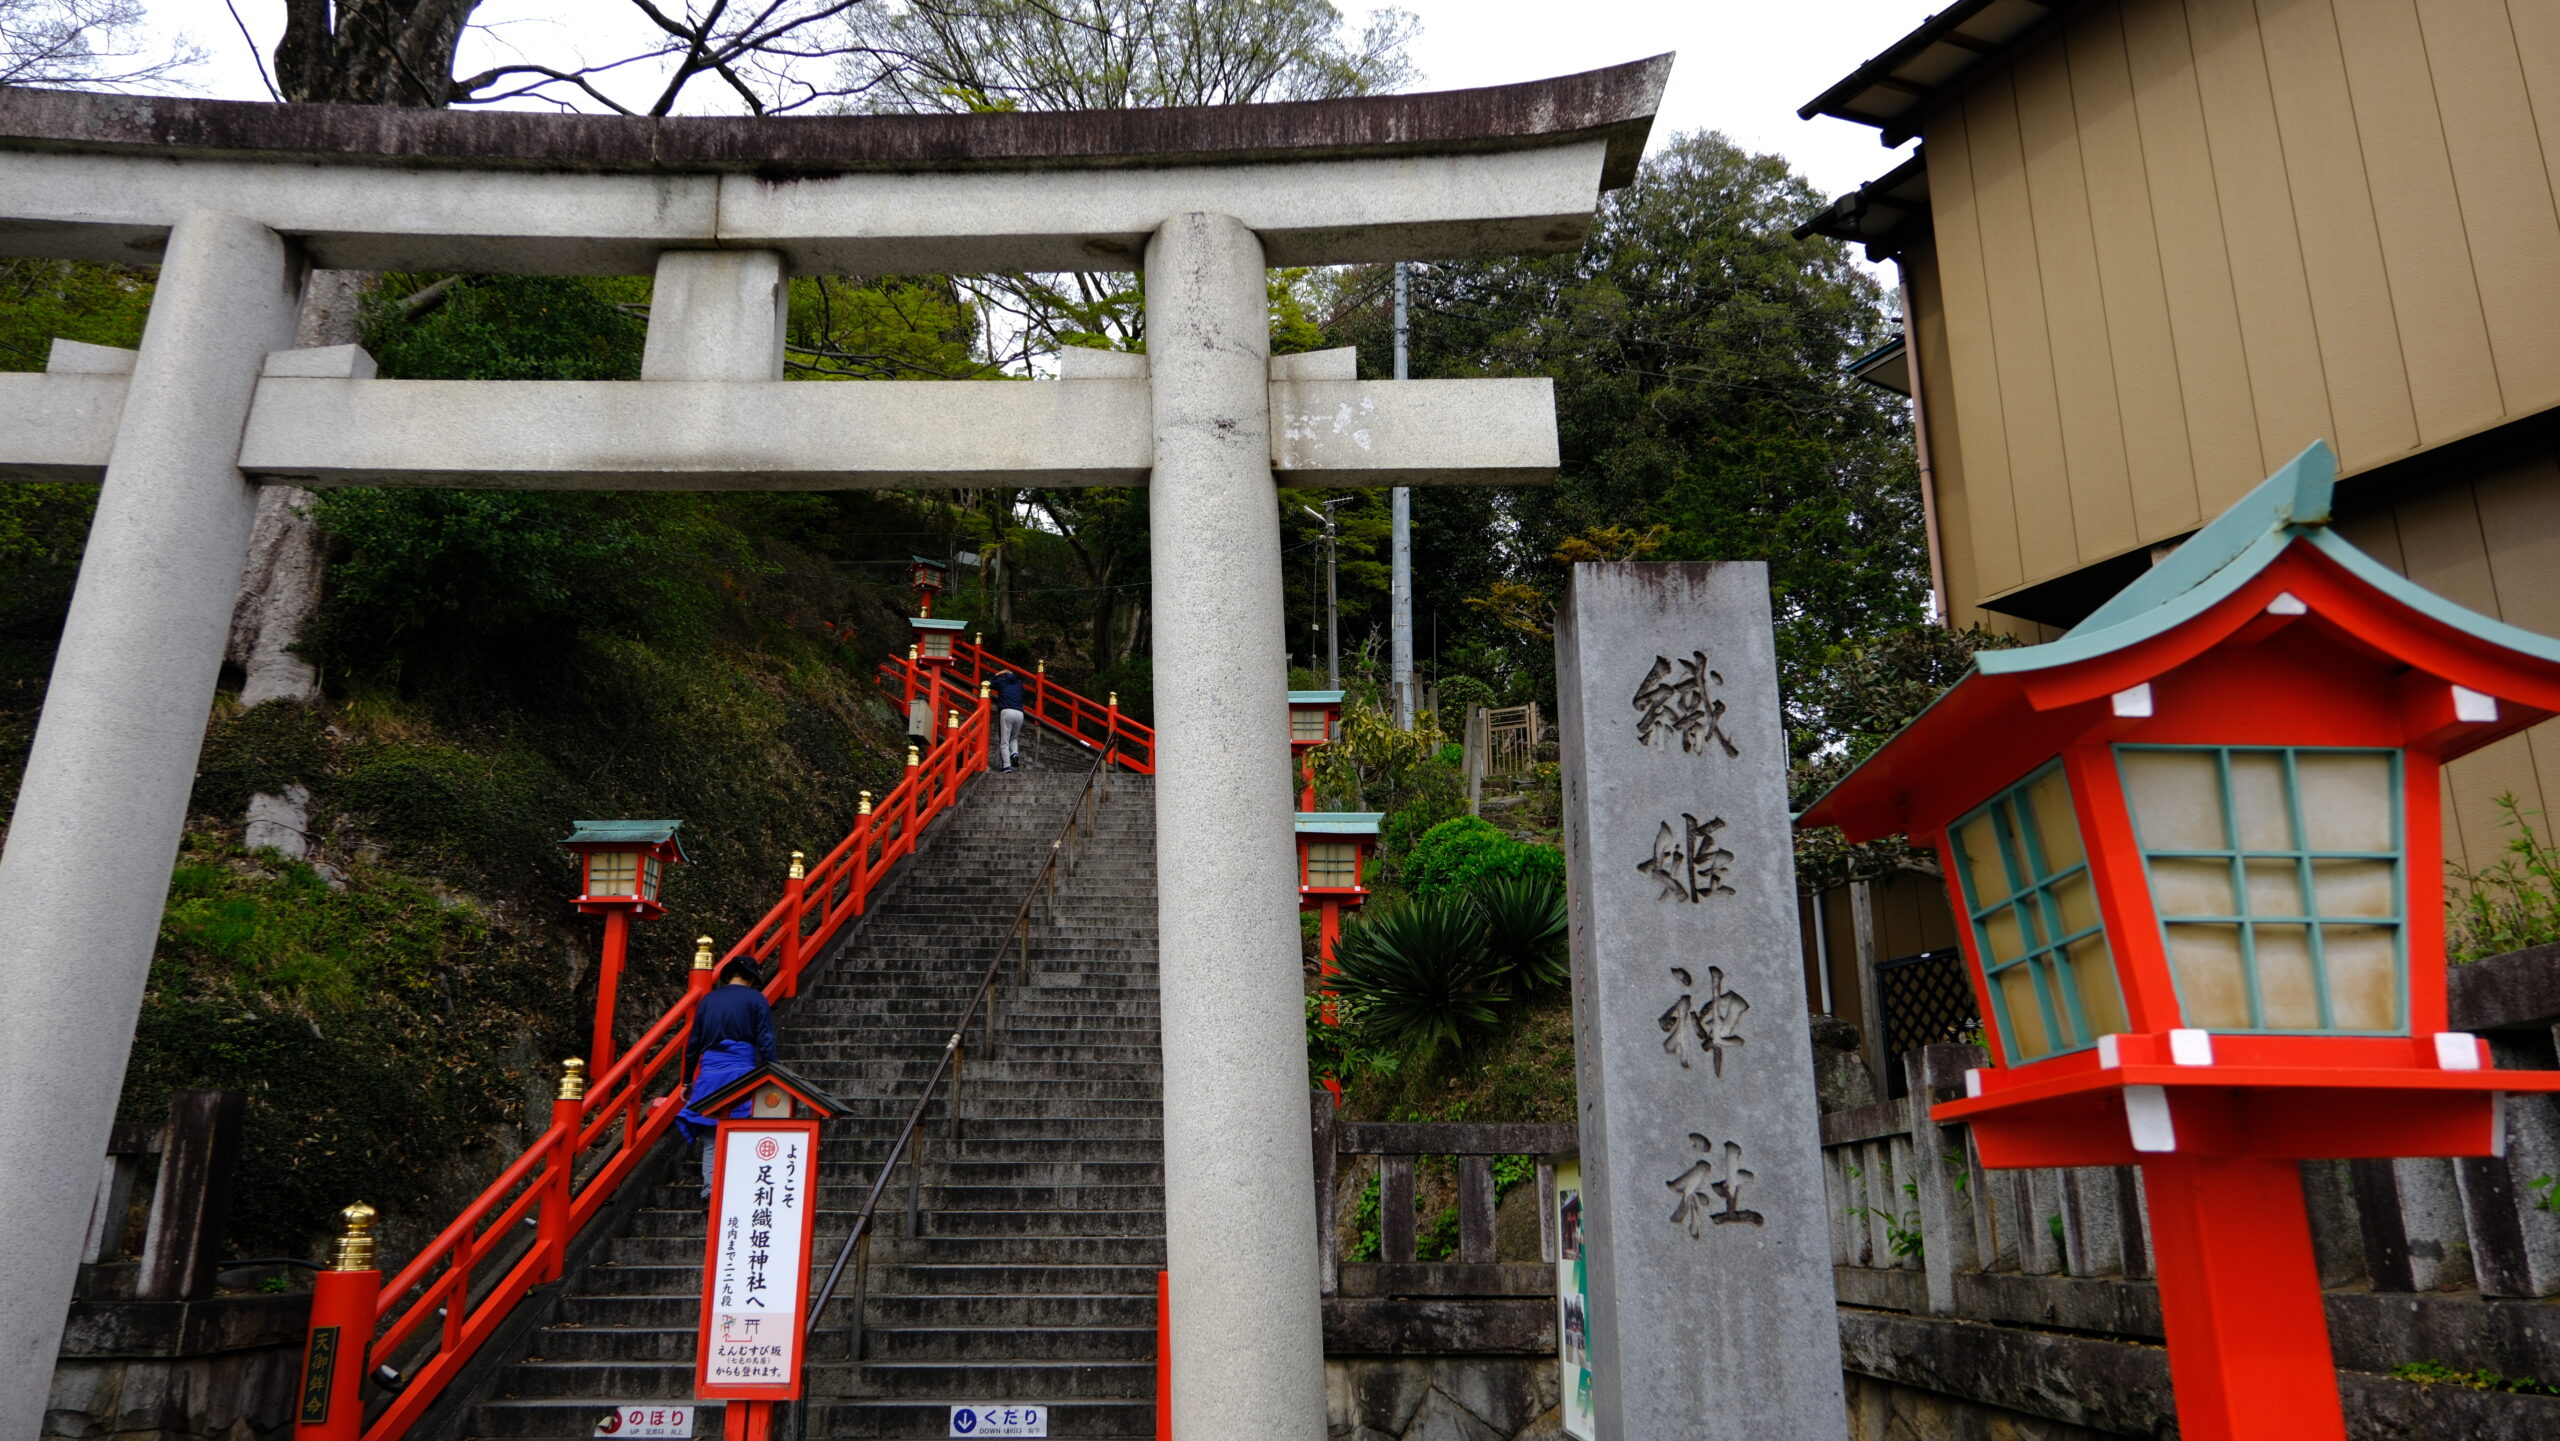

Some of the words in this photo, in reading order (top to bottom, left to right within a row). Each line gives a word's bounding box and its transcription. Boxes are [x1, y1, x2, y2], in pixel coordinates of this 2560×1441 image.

[1633, 650, 1765, 1239] 織姫神社
[781, 1144, 797, 1209] ようこそ
[746, 1165, 775, 1308] 足利織姫神社へ
[720, 1216, 739, 1307] 境内まで二二九段
[717, 1345, 782, 1357] えんむすび坂
[716, 1366, 782, 1378] からも登れます。
[629, 1410, 684, 1426] のぼり
[984, 1409, 1037, 1425] くだり
